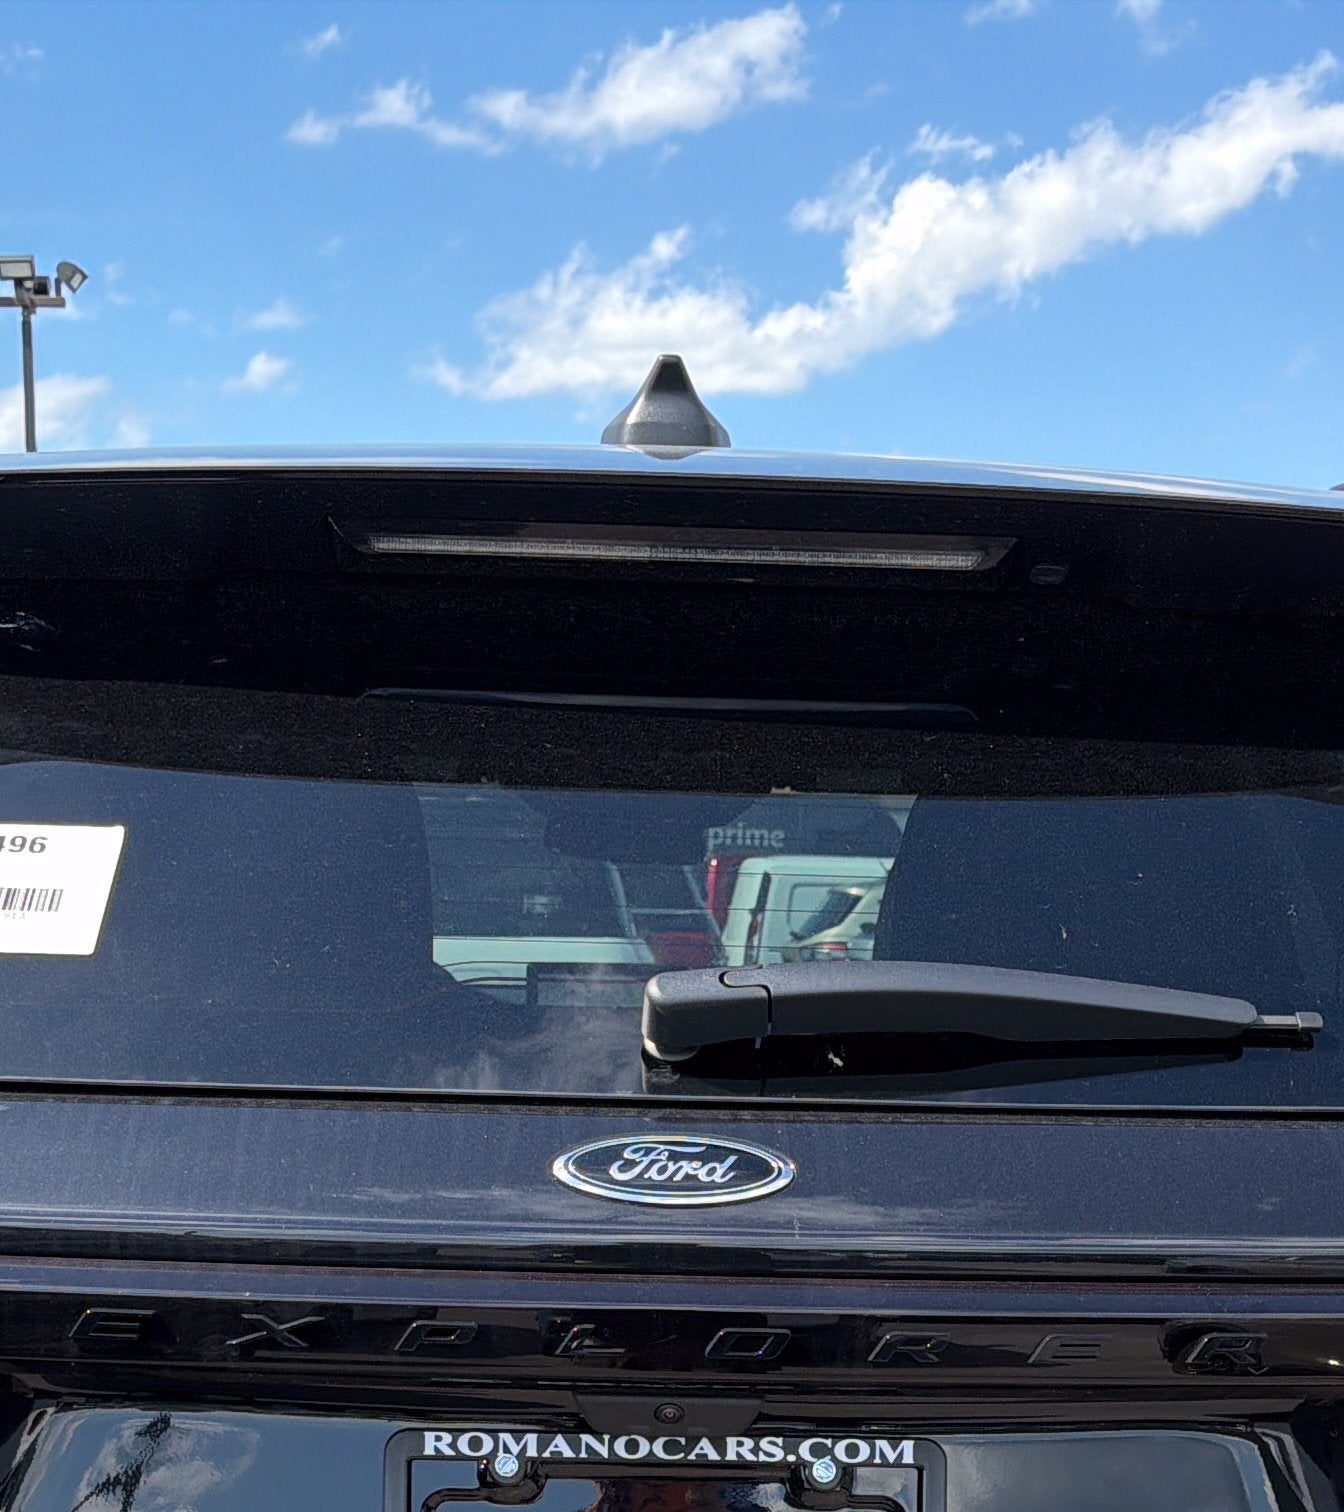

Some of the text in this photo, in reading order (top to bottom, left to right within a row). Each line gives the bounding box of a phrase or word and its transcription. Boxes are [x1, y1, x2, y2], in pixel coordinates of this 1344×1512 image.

[707, 821, 786, 853] prime
[608, 1142, 739, 1184] Ford
[67, 1307, 1270, 1374] EXPLORER
[422, 1430, 916, 1466] ROMANOCARS.COM
